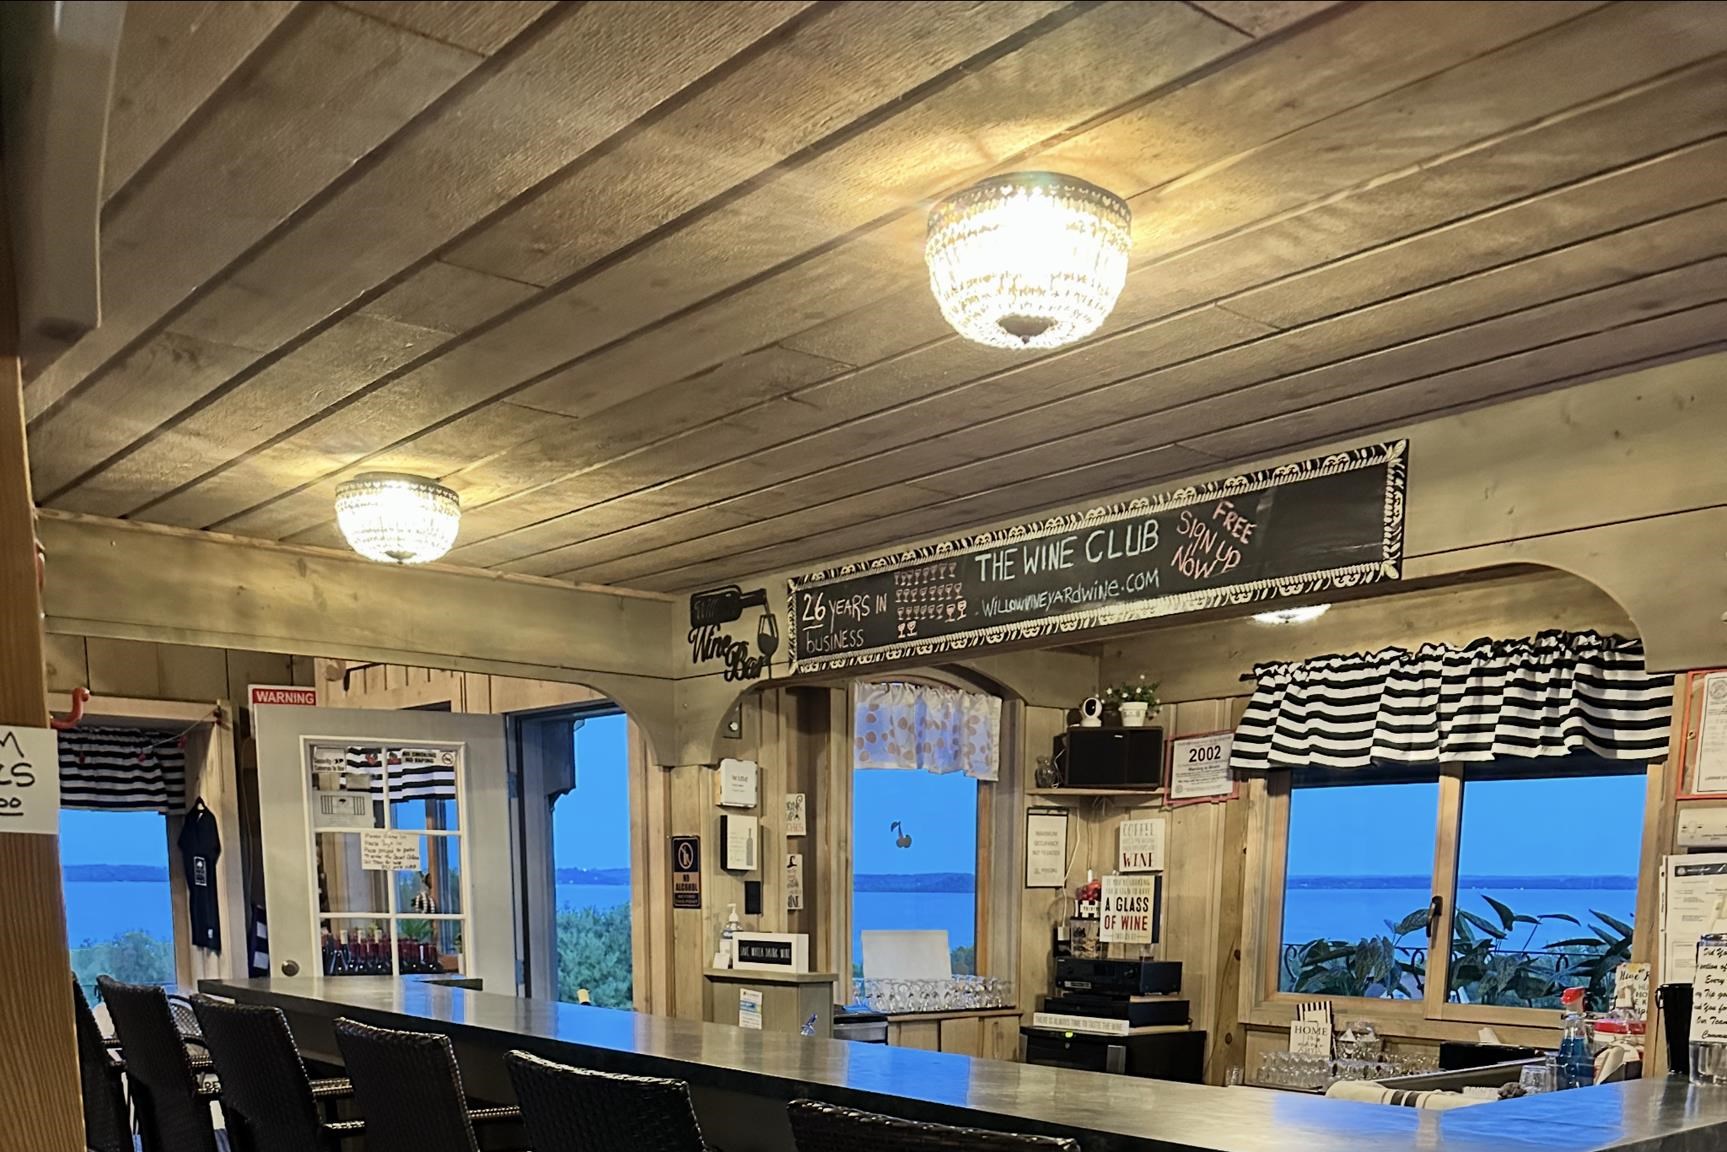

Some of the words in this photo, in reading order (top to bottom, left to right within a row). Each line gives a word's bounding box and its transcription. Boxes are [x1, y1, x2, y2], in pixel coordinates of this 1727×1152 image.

[1212, 501, 1257, 544] FREE
[975, 548, 1018, 582] THE
[1023, 536, 1078, 575] WINE
[1085, 519, 1159, 563] CLUB
[1170, 543, 1218, 580] NOW
[1216, 540, 1241, 574] UP
[802, 592, 826, 621] 26
[829, 594, 870, 633] YEARS
[876, 593, 887, 614] IN
[688, 624, 732, 664] Wine
[724, 641, 764, 682] Bar
[256, 690, 315, 704] WARNING
[1188, 745, 1221, 763] 2002
[1122, 852, 1153, 868] WINE
[1104, 897, 1111, 912] A
[1116, 897, 1149, 912] GLASS
[1104, 915, 1116, 930] OF
[1121, 915, 1148, 931] WINE
[1294, 1025, 1328, 1036] HOME
